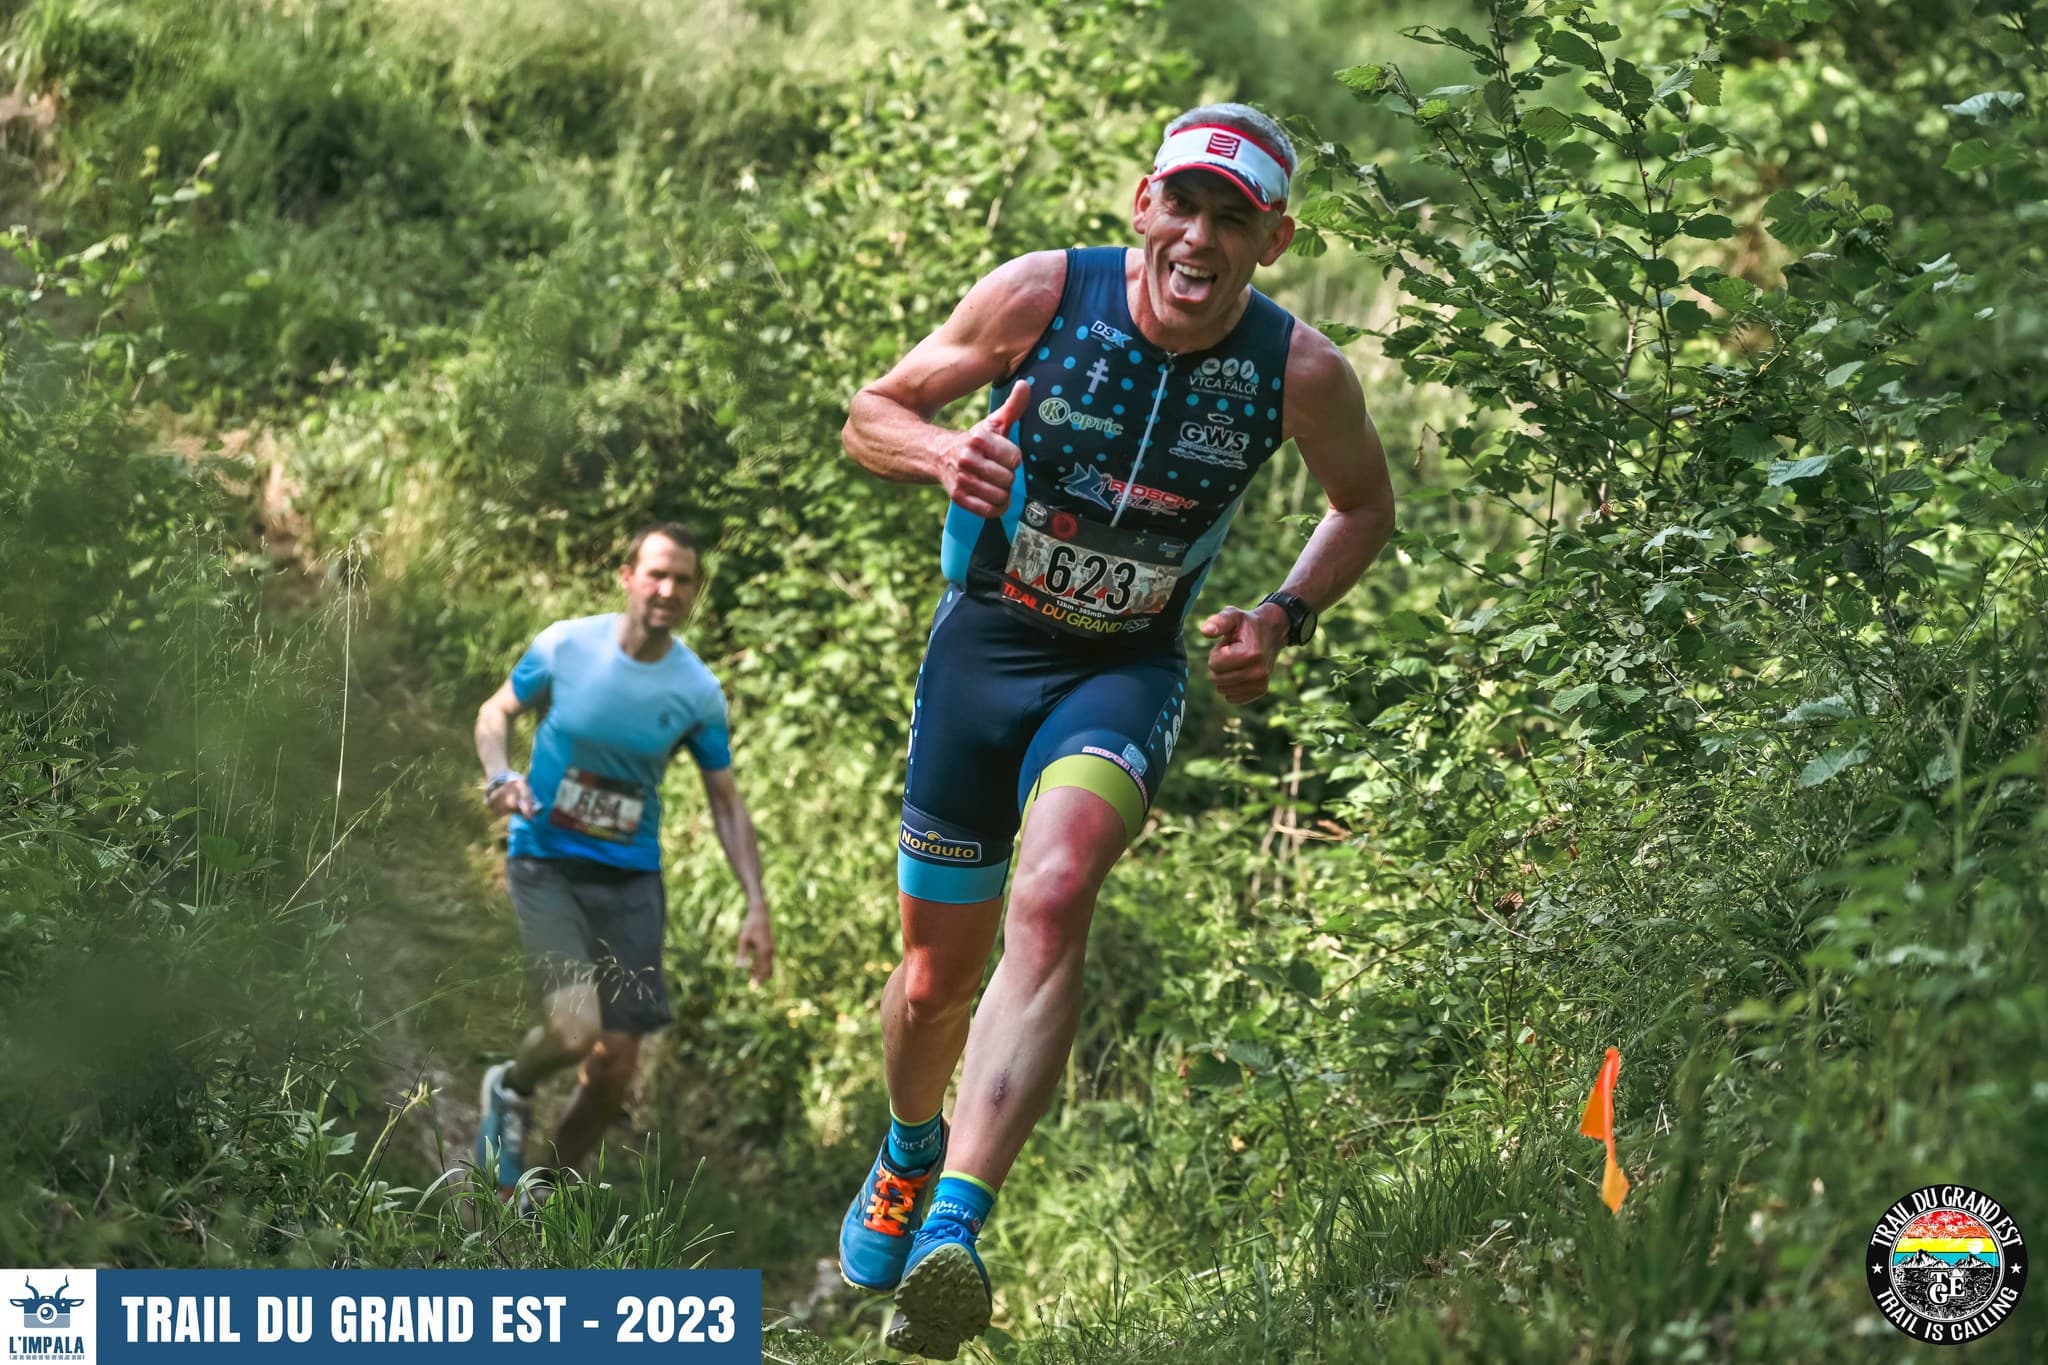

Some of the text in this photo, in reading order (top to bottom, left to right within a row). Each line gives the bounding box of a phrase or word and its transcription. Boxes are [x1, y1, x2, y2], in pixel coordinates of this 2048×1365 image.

[1224, 380, 1258, 396] FALCK
[1180, 422, 1249, 452] GWS
[1046, 546, 1137, 611] 623
[1041, 603, 1066, 621] DU
[1066, 612, 1123, 634] GRAND
[901, 829, 975, 859] Norauto
